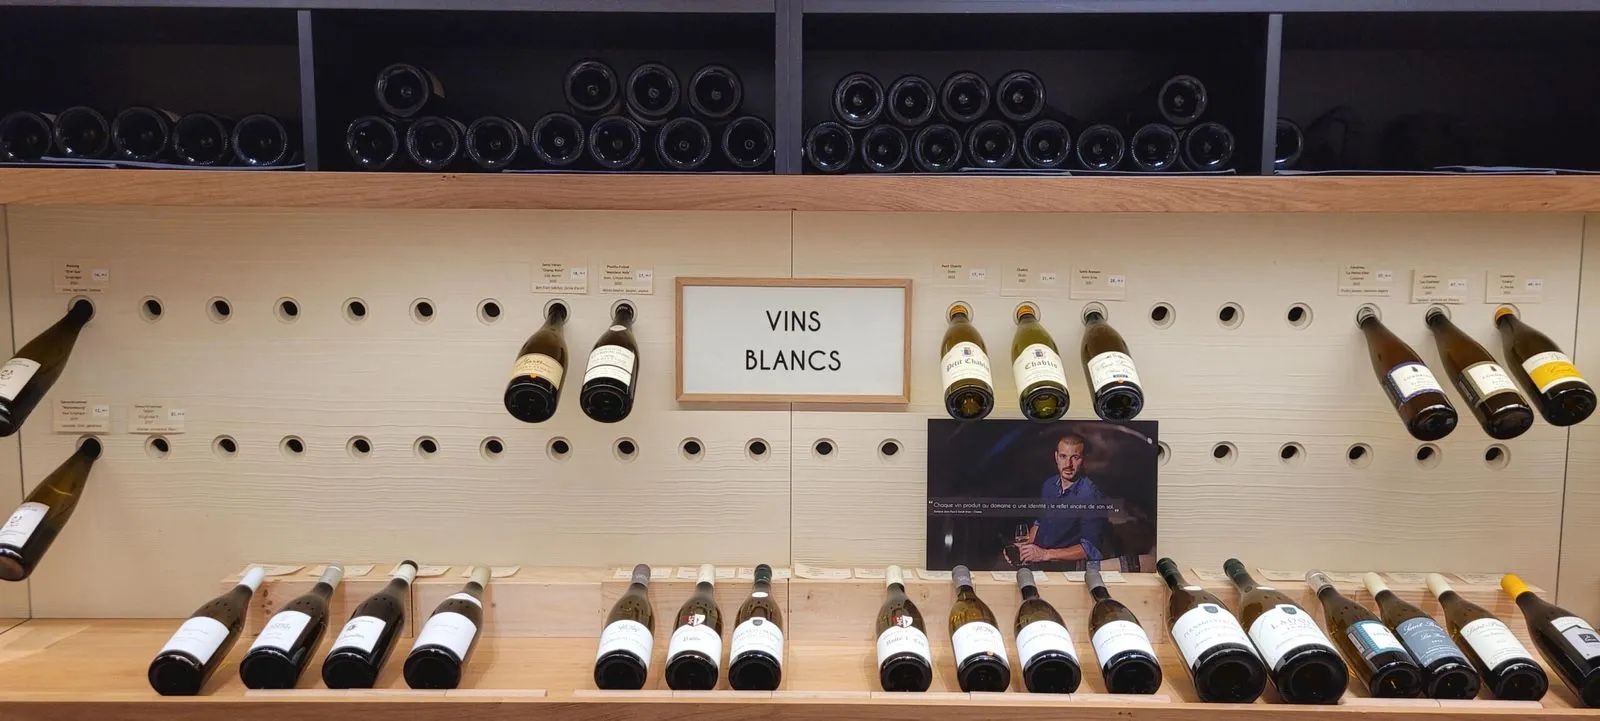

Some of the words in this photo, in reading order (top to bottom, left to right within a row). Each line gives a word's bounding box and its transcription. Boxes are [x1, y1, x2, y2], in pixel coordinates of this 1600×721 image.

[766, 310, 821, 332] VINS
[745, 349, 842, 372] BLANCS
[946, 359, 963, 372] Petit
[1024, 360, 1058, 370] Chablis
[933, 501, 954, 509] Chaque
[963, 501, 981, 509] produit
